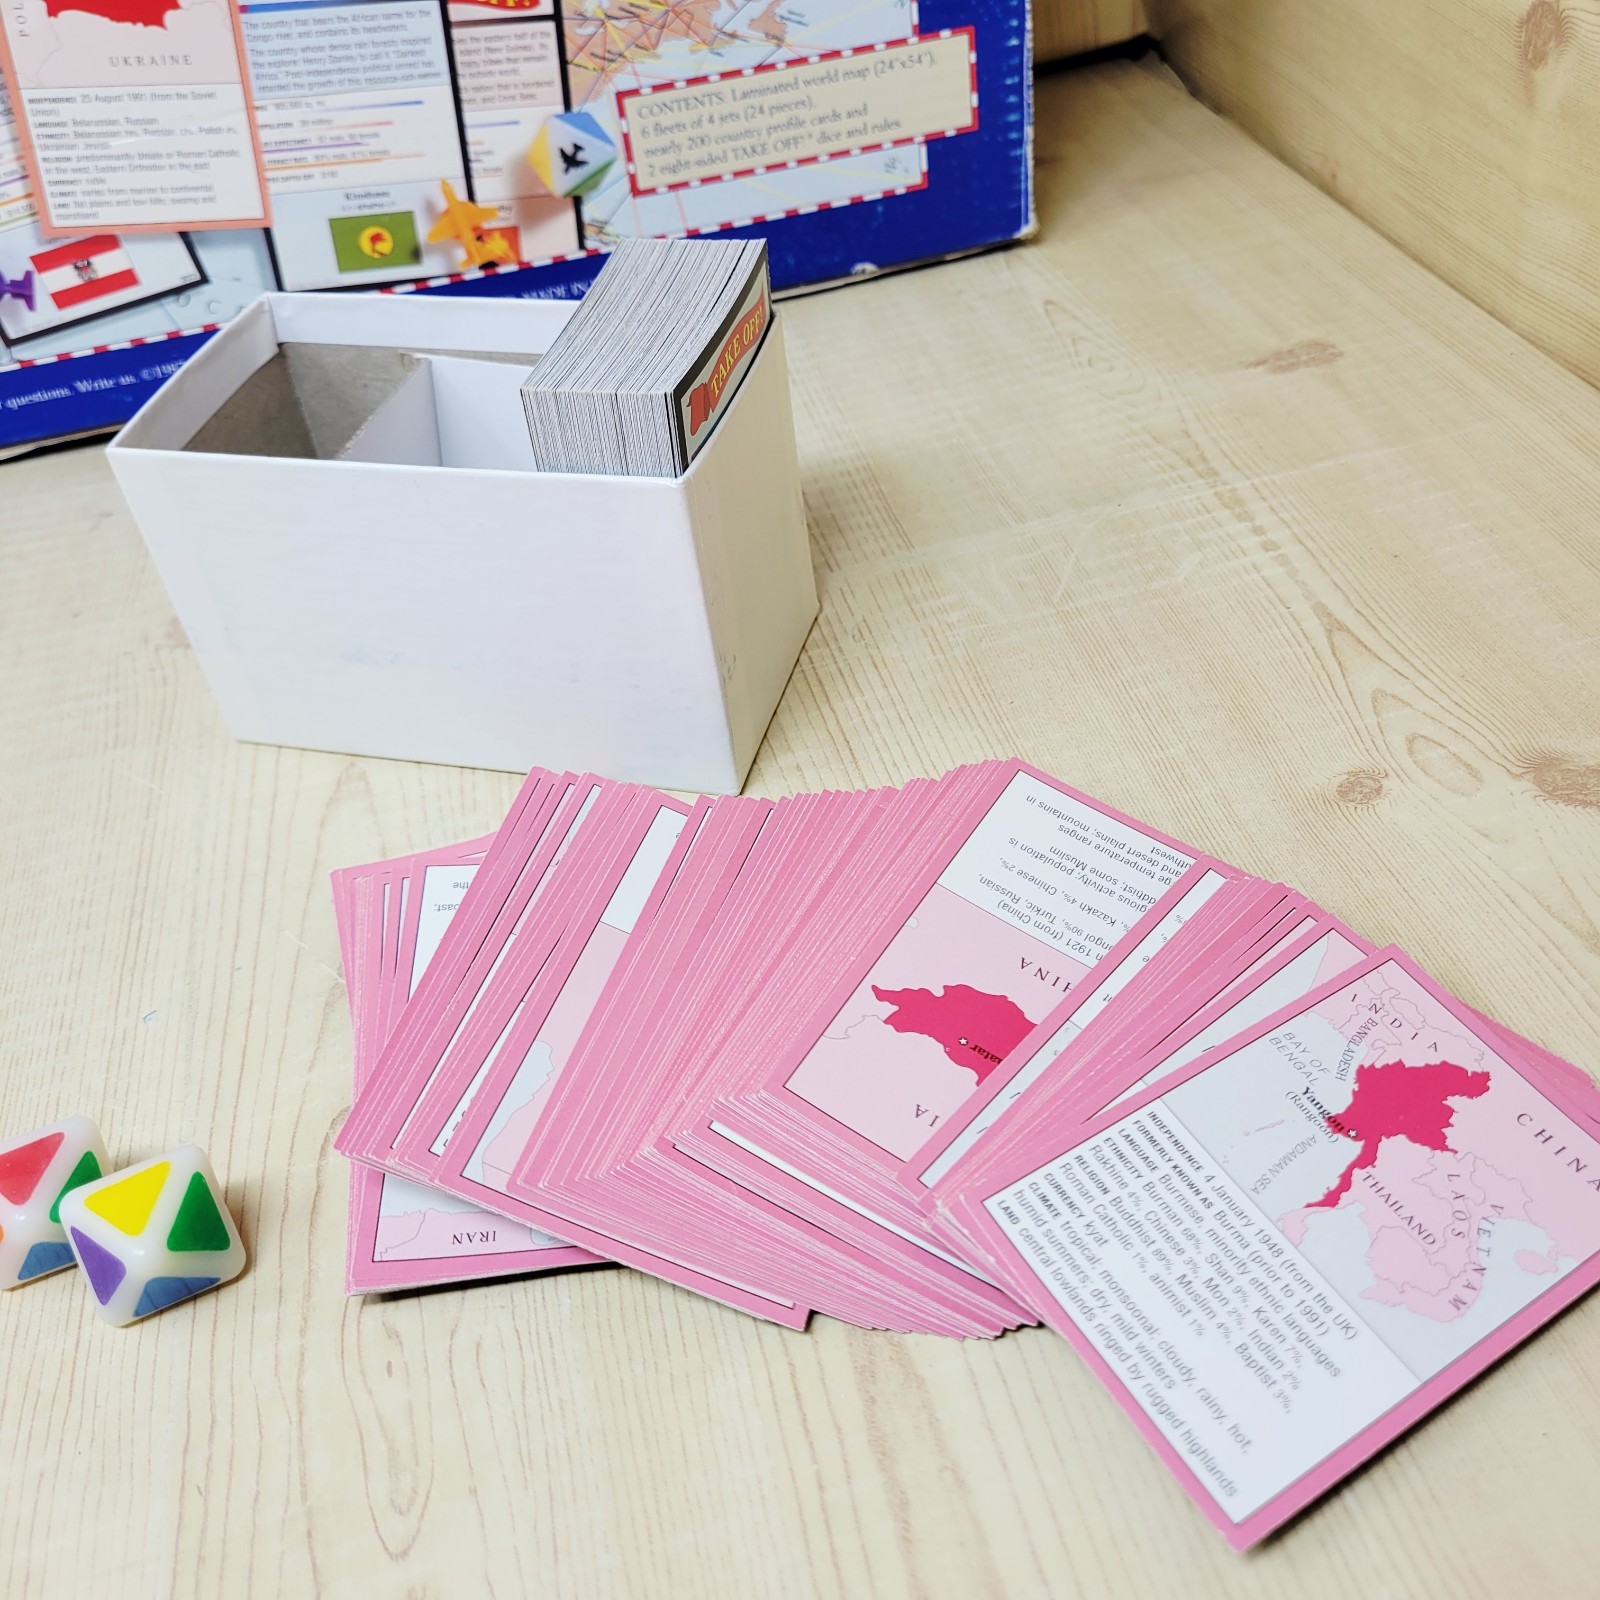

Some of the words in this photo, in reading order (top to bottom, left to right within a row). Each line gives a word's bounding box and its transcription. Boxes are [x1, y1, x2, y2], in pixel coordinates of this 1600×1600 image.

[260, 19, 293, 30] country
[293, 18, 308, 27] that
[336, 15, 349, 23] the
[351, 13, 379, 22] African
[381, 12, 403, 20] name
[404, 10, 417, 19] for
[418, 9, 431, 18] the
[108, 54, 194, 68] UKRAINE
[729, 75, 800, 103] Laminated
[801, 68, 840, 88] world
[841, 66, 870, 81] map
[640, 125, 651, 139] 6
[652, 121, 687, 137] fleets
[689, 113, 704, 130] of
[707, 113, 715, 125] 4
[717, 111, 741, 127] jets
[743, 103, 766, 122] (24
[643, 139, 683, 159] nearly
[687, 134, 711, 151] 200
[713, 128, 763, 146] country
[764, 115, 807, 139] profile
[809, 109, 842, 126] cards
[845, 102, 868, 120] and
[647, 163, 656, 178] 2
[658, 149, 729, 175] eight-sided
[731, 142, 768, 161] TAKE
[816, 130, 842, 145] dice
[845, 122, 868, 139] and
[710, 334, 741, 398] TAKE
[742, 308, 765, 344] OFF!
[72, 377, 117, 393] Write
[1025, 794, 1037, 804] in
[1036, 800, 1091, 832] mountains
[1007, 836, 1019, 849] is
[1057, 824, 1093, 846] ranges
[1093, 828, 1127, 850] plains;
[999, 856, 1016, 872] 2%,
[1019, 843, 1075, 876] population
[1048, 845, 1088, 872] Muslim
[1093, 842, 1156, 880] temperature
[1126, 846, 1160, 868] desert
[1159, 863, 1182, 878] and
[453, 881, 469, 890] the
[978, 873, 1022, 905] Russian,
[1015, 868, 1058, 896] Chinese
[1074, 871, 1116, 898] activity;
[1088, 866, 1119, 886] some
[996, 898, 1032, 924] China)
[1024, 898, 1057, 925] Turkic,
[1060, 890, 1078, 905] 4%,
[1078, 901, 1117, 928] Kazakh
[1032, 919, 1064, 941] (from
[1061, 918, 1084, 937] 90%,
[1065, 937, 1092, 957] 1921
[1351, 993, 1439, 1053] INDIA
[1268, 1036, 1321, 1087] BENGAL
[1282, 1031, 1309, 1054] BAY
[1309, 1057, 1331, 1075] OF
[1335, 1017, 1377, 1082] BANGLADESH
[1284, 1090, 1339, 1144] (Rangoon)
[1302, 1086, 1345, 1133] Yangon
[1273, 1135, 1318, 1176] ANDAMAN
[1516, 1113, 1600, 1192] CHINA
[1250, 1172, 1272, 1196] SEA
[1043, 1172, 1086, 1219] CURRENCY
[1082, 1219, 1109, 1248] kyat
[1362, 1171, 1437, 1247] THAILAND
[1447, 1172, 1466, 1240] LAOS
[452, 1229, 497, 1246] IRAN
[1131, 1119, 1174, 1163] FORMERLY
[1170, 1163, 1203, 1197] KNOWN
[1198, 1196, 1214, 1209] AS
[1212, 1209, 1250, 1250] Burma
[1246, 1249, 1282, 1288] (prior
[1279, 1282, 1295, 1298] to
[1298, 1300, 1330, 1337] 1991)
[1146, 1110, 1203, 1172] INDEPENDENCE
[1204, 1174, 1216, 1183] 4
[1210, 1184, 1255, 1227] January
[1253, 1228, 1284, 1258] 1948
[1278, 1258, 1314, 1294] (from
[1312, 1291, 1334, 1314] the
[1331, 1312, 1358, 1340] UK)
[1058, 1161, 1096, 1204] Roman
[1092, 1203, 1133, 1251] Catholic
[1130, 1251, 1150, 1274] 1%,
[1148, 1272, 1192, 1318] animist
[1187, 1318, 1206, 1337] 1%
[1088, 1143, 1129, 1190] Rakhine
[1126, 1191, 1143, 1212] 4%,
[1143, 1209, 1186, 1256] Chinese
[1181, 1255, 1201, 1279] 3%,
[1201, 1276, 1230, 1307] Mon
[1225, 1306, 1246, 1331] 2%,
[1246, 1328, 1285, 1370] Indian
[1281, 1369, 1301, 1391] 2%
[1102, 1136, 1144, 1179] ETHNICITY
[1141, 1180, 1184, 1227] Burman
[1180, 1226, 1203, 1255] 68%,
[1204, 1252, 1235, 1285] Shan
[1231, 1284, 1250, 1308] 9%,
[1251, 1305, 1287, 1344] Karen
[1283, 1343, 1303, 1369] 7%,
[1117, 1127, 1159, 1172] LANGUAGE
[1157, 1172, 1205, 1228] Burmese,
[1204, 1227, 1252, 1276] minority
[1248, 1276, 1284, 1314] ethnic
[1281, 1312, 1341, 1377] languages
[1448, 1203, 1505, 1312] VIETNAM
[1012, 1188, 1049, 1228] humid
[1041, 1227, 1093, 1288] summers;
[1089, 1287, 1112, 1313] dry,
[1109, 1312, 1141, 1341] mild
[1134, 1341, 1176, 1390] winters
[1073, 1154, 1111, 1195] RELIGION
[1108, 1195, 1157, 1248] Buddhist
[1150, 1247, 1174, 1275] 89%,
[1174, 1272, 1217, 1320] Muslim
[1215, 1321, 1233, 1344] 4%,
[1233, 1341, 1278, 1389] Baptist
[1272, 1388, 1292, 1414] 3%,
[1028, 1181, 1062, 1218] CLIMATE
[1059, 1219, 1102, 1270] tropical;
[1097, 1269, 1161, 1340] monsoonal;
[1157, 1339, 1197, 1387] cloudy,
[1195, 1386, 1228, 1425] rainy,
[1226, 1422, 1252, 1454] hot,
[996, 1199, 1020, 1225] LAND
[1017, 1227, 1057, 1268] central
[1049, 1266, 1096, 1322] lowlands
[1093, 1322, 1133, 1363] ringed
[1126, 1361, 1146, 1381] by
[1141, 1382, 1186, 1430] rugged
[1180, 1427, 1239, 1498] highlands
